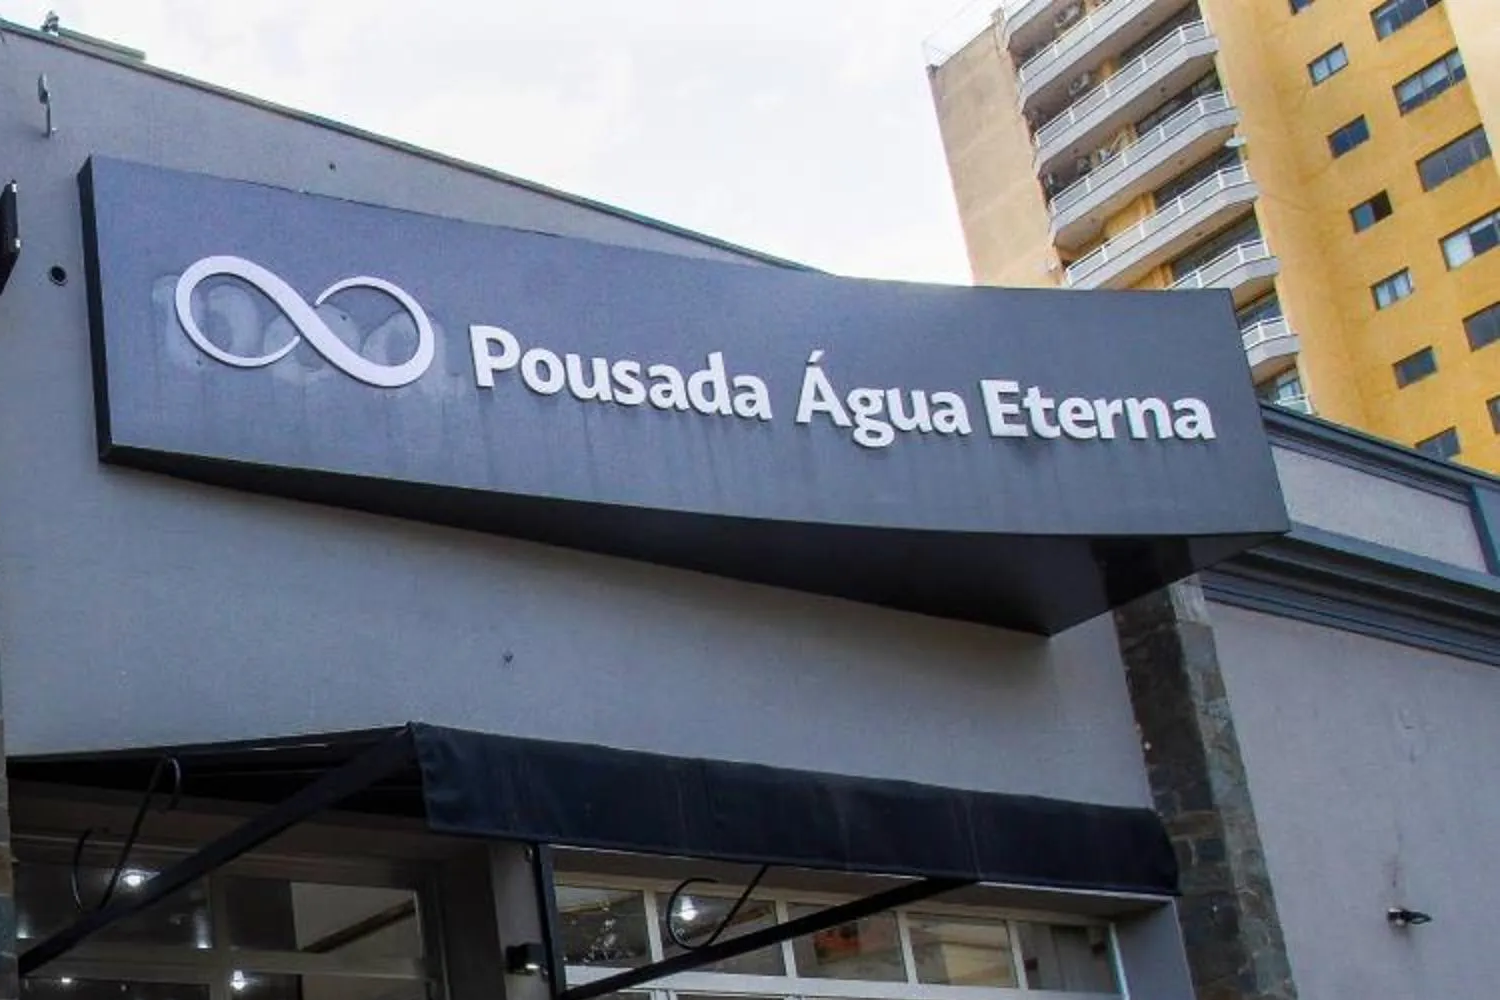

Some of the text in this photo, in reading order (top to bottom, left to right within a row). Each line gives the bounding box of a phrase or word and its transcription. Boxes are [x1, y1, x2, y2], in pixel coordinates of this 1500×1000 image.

[469, 324, 1217, 447] Pousada Água Eterna
